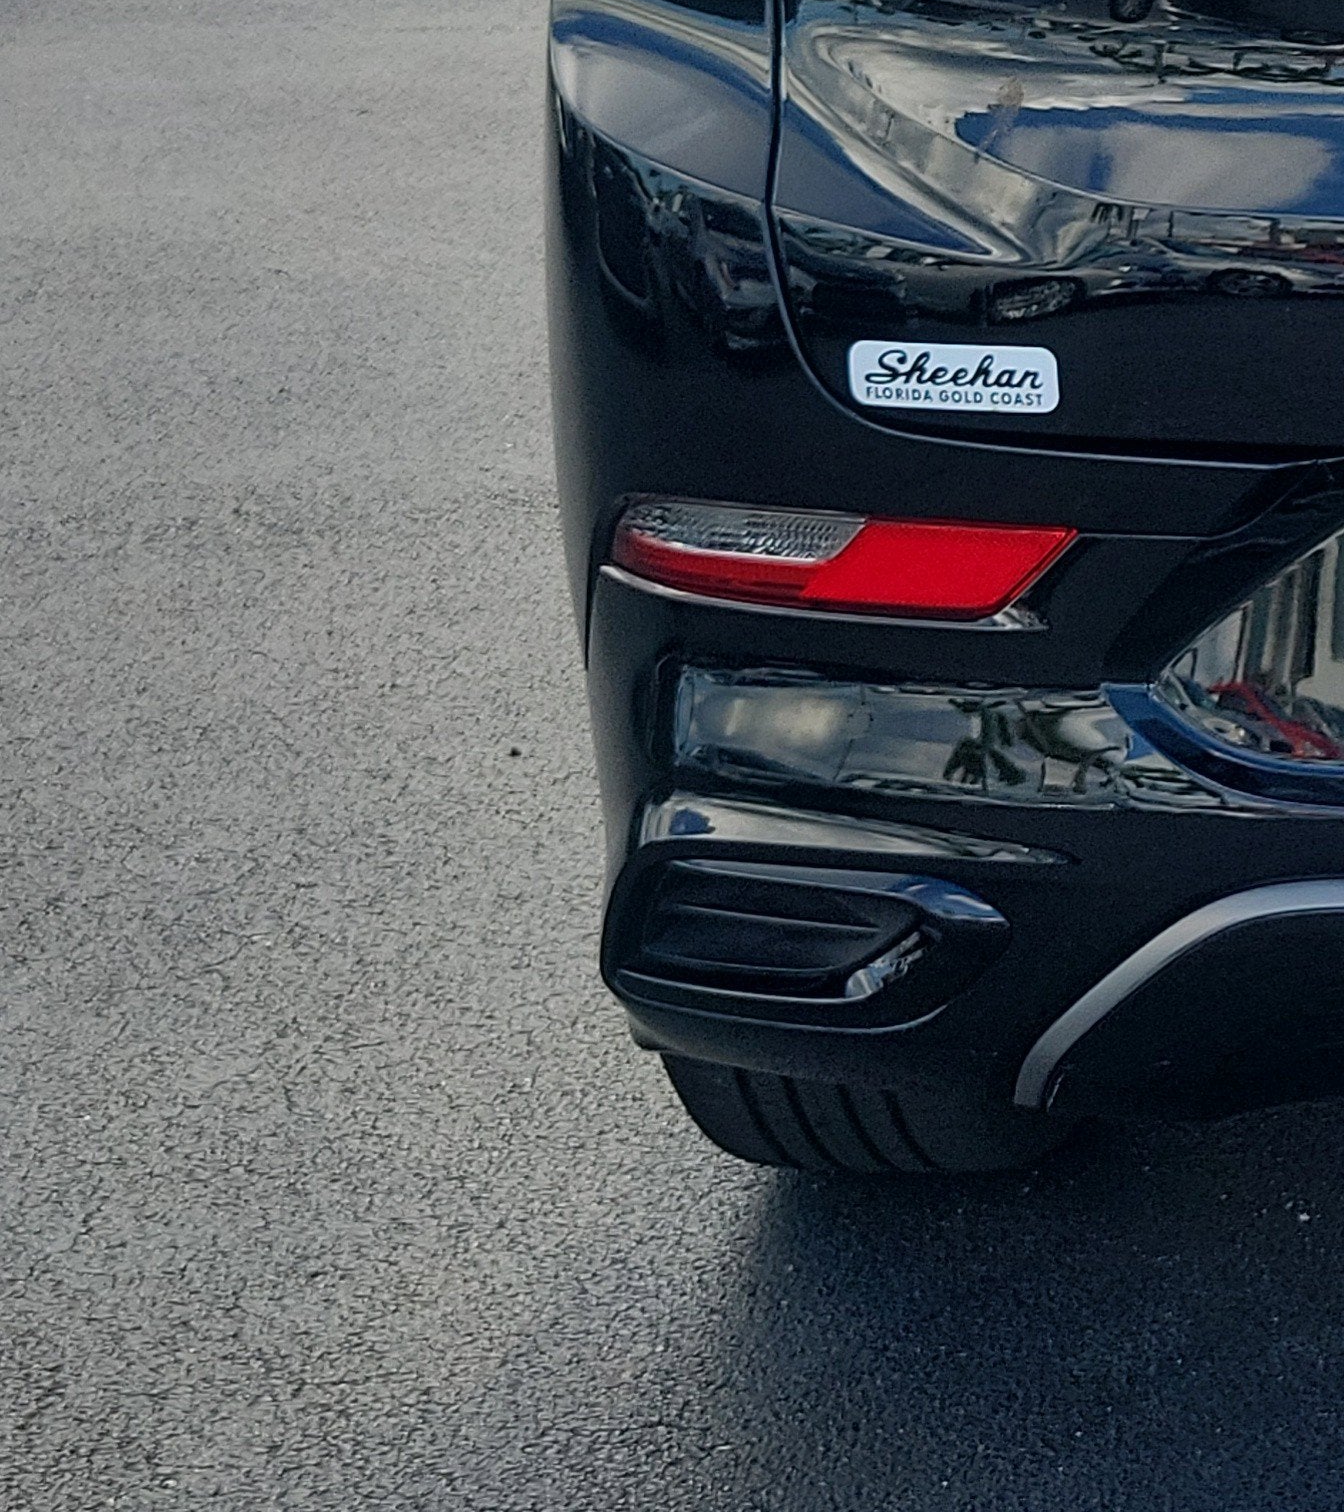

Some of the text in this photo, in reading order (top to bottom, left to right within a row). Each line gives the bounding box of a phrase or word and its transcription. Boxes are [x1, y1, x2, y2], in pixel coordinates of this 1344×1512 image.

[864, 349, 1043, 389] Sheehan
[866, 386, 1043, 406] FLORIDA GOLD COAST
